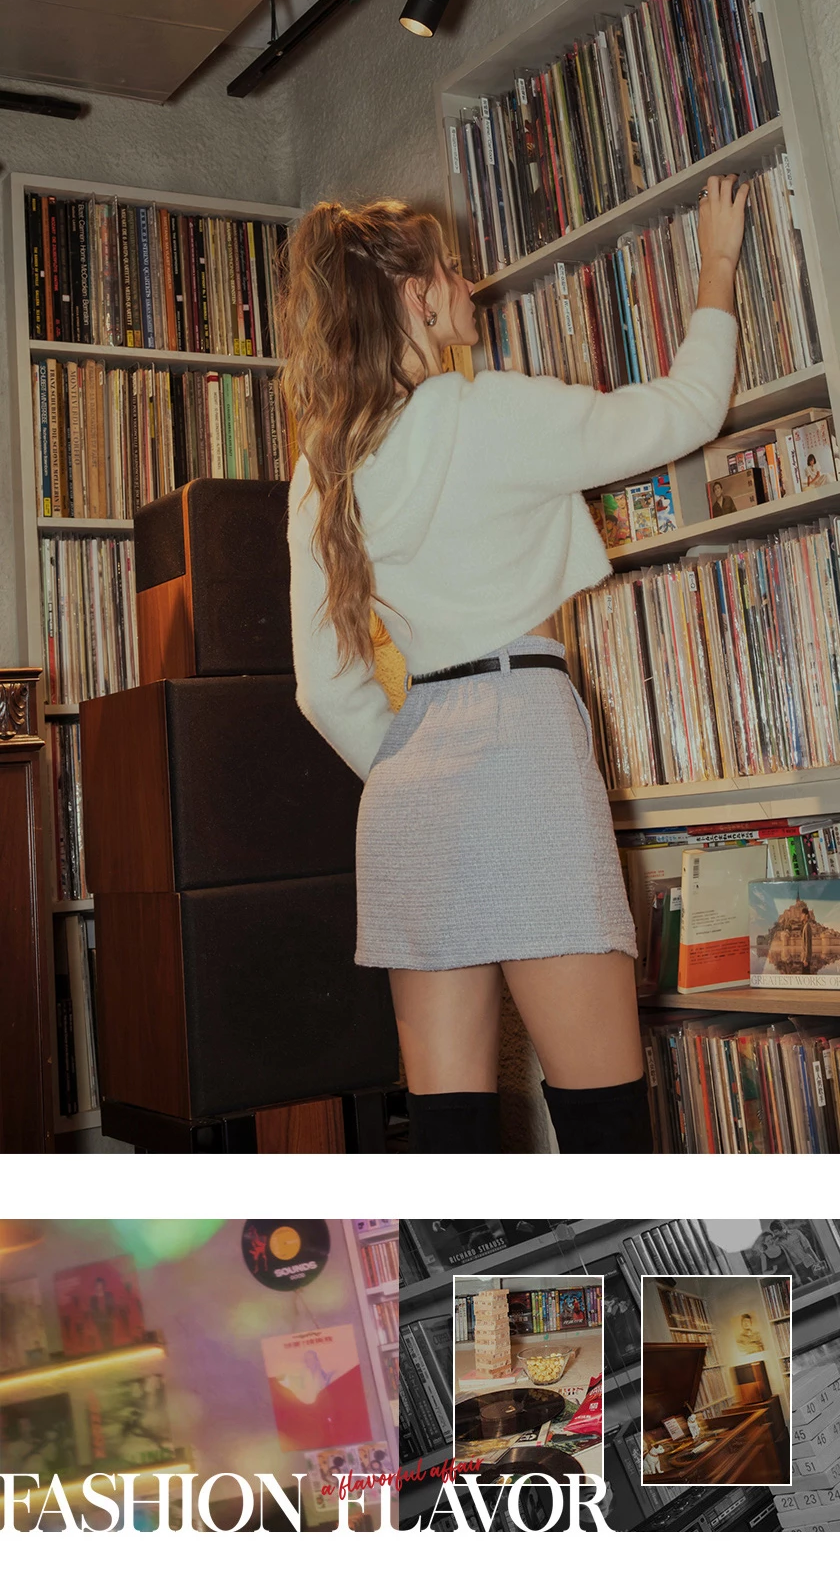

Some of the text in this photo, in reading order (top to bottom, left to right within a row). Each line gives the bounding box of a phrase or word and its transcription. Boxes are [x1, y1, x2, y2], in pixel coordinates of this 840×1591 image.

[70, 370, 79, 425] MONTEVERDI
[751, 976, 800, 986] GREATEST
[801, 975, 826, 986] WORKS
[449, 1237, 505, 1264] RICHARD STRAUSS
[274, 1260, 318, 1278] SOUNDS
[819, 1392, 829, 1404] 41
[806, 1404, 816, 1415] 40
[794, 1430, 806, 1441] 45
[816, 1435, 827, 1446] 46
[805, 1461, 816, 1473] 51
[781, 1497, 794, 1509] 22
[804, 1494, 817, 1505] 23
